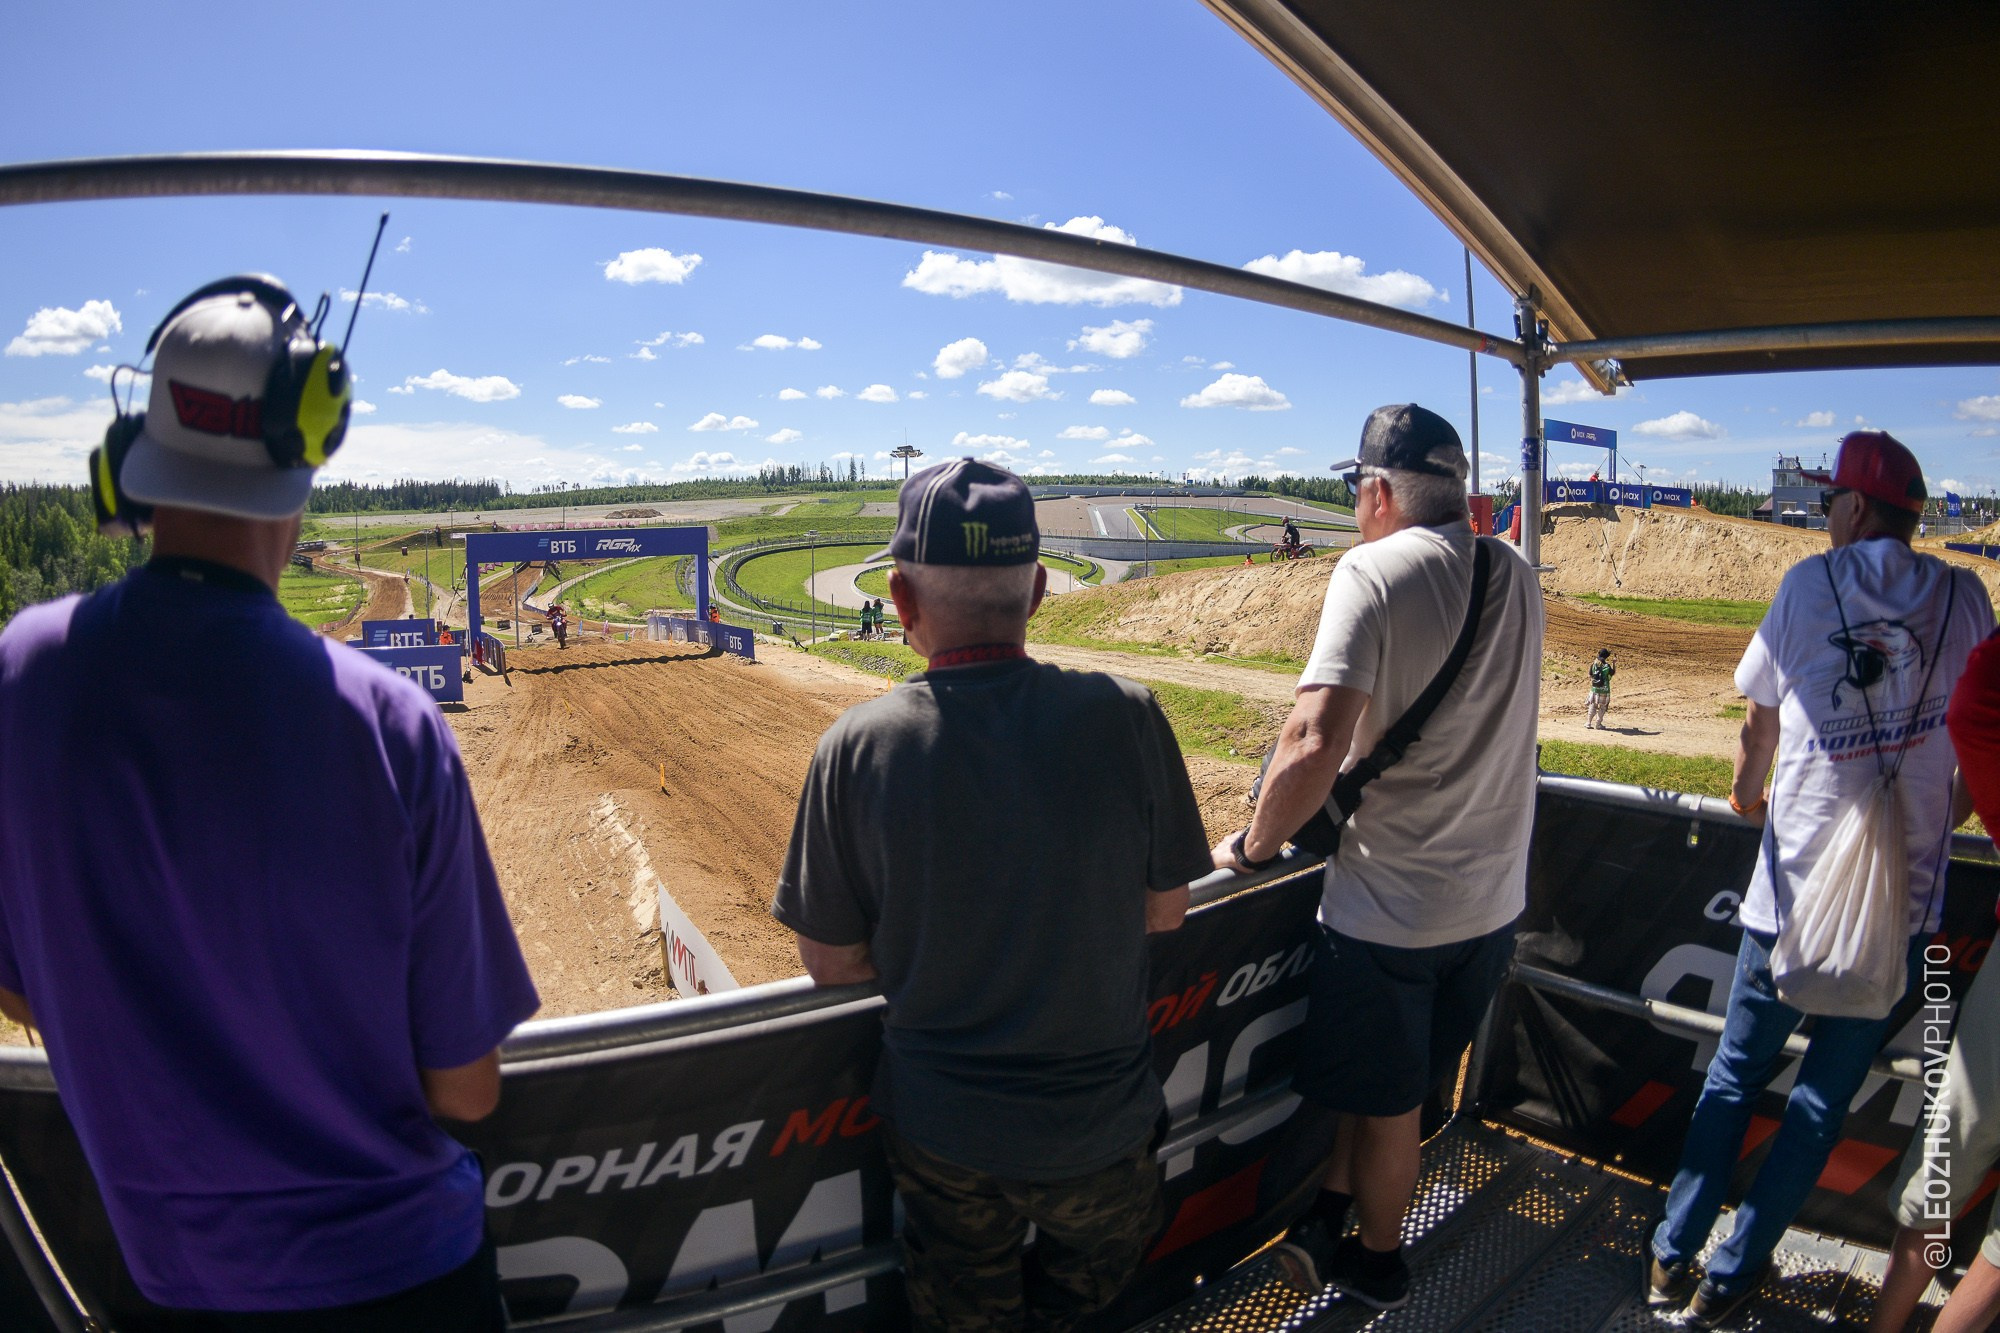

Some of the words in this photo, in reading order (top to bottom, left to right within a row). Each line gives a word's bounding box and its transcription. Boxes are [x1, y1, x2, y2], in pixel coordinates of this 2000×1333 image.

[550, 540, 577, 554] ВТБ
[390, 632, 425, 647] ВТБ
[729, 635, 743, 651] ВТБ
[1704, 889, 1746, 928] С
[485, 1119, 765, 1207] ОРНАЯ
[1216, 942, 1316, 1007] ОБЛ
